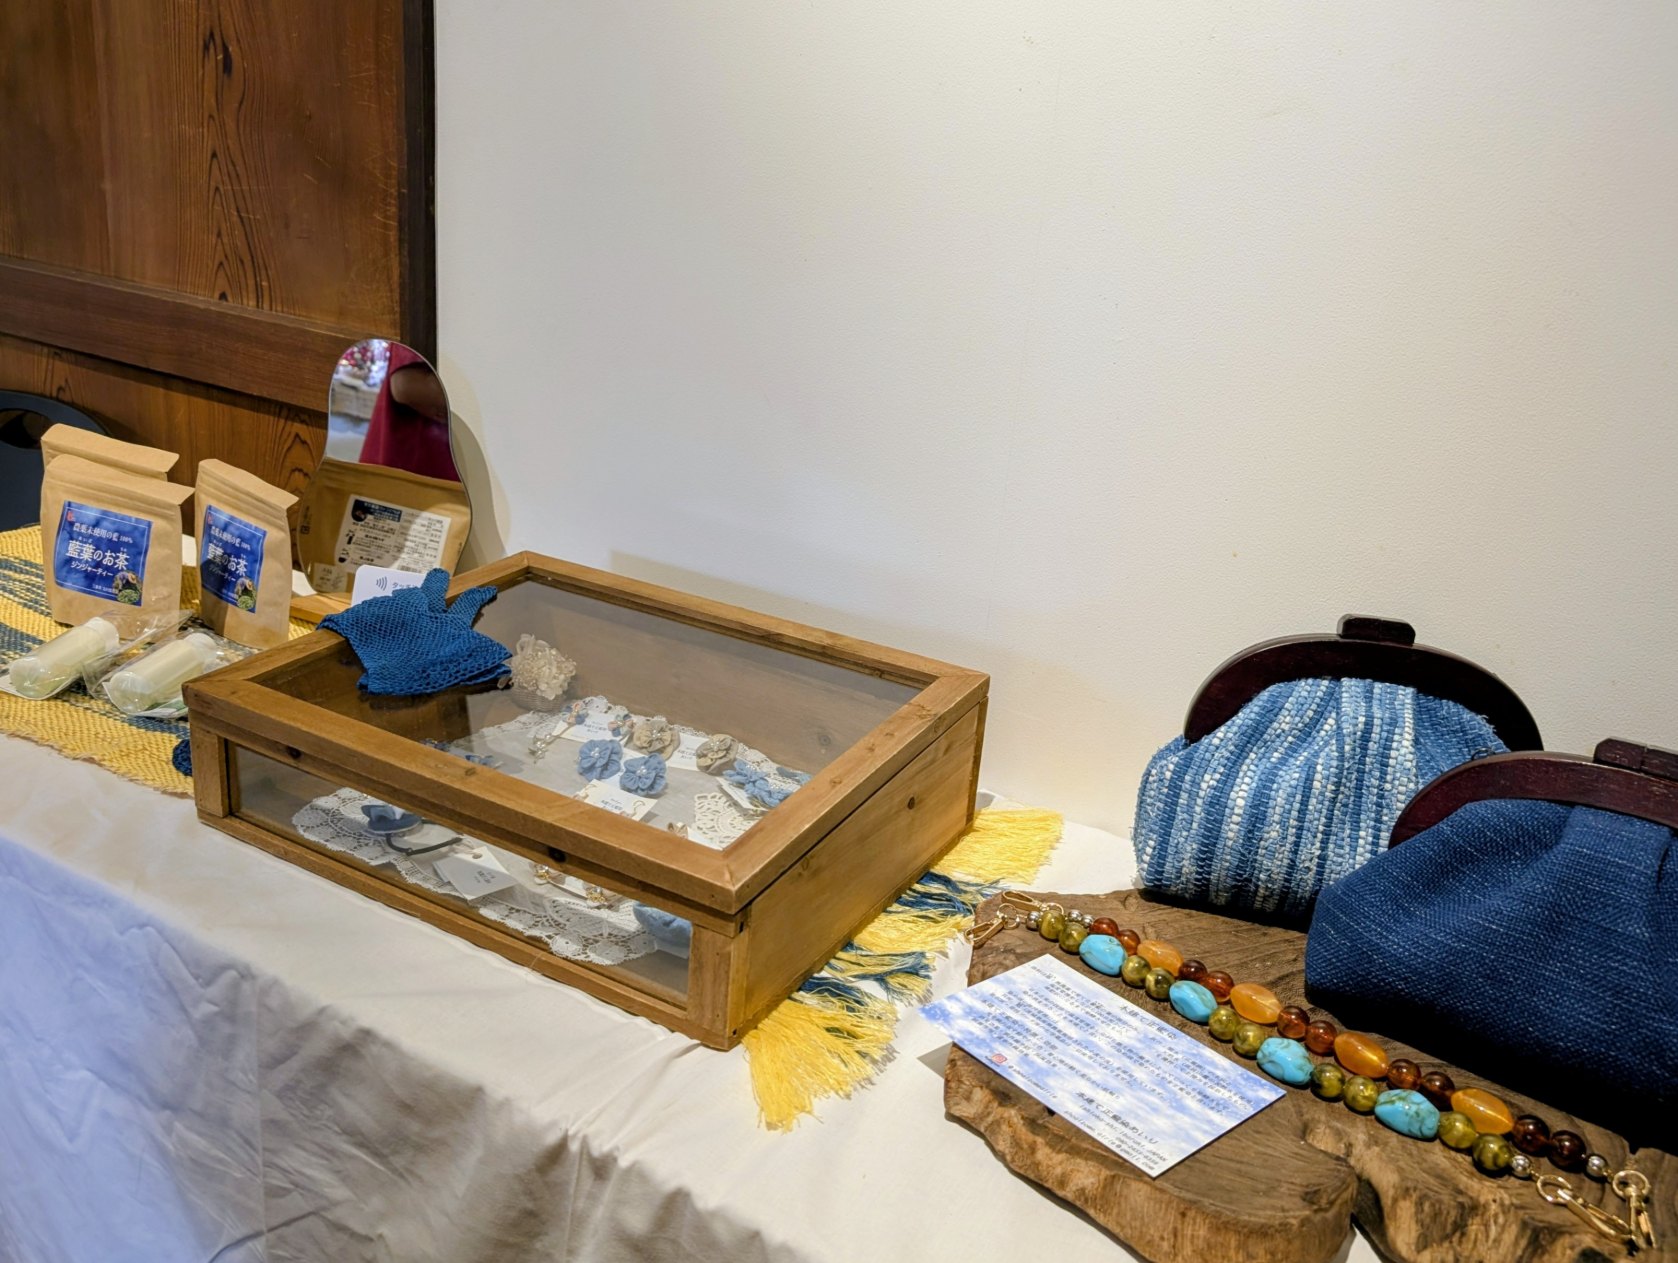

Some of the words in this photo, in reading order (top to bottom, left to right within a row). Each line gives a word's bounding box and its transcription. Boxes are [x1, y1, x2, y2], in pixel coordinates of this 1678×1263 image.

[65, 540, 131, 570] 藍葉のお茶
[70, 561, 114, 577] ジンジャーティー
